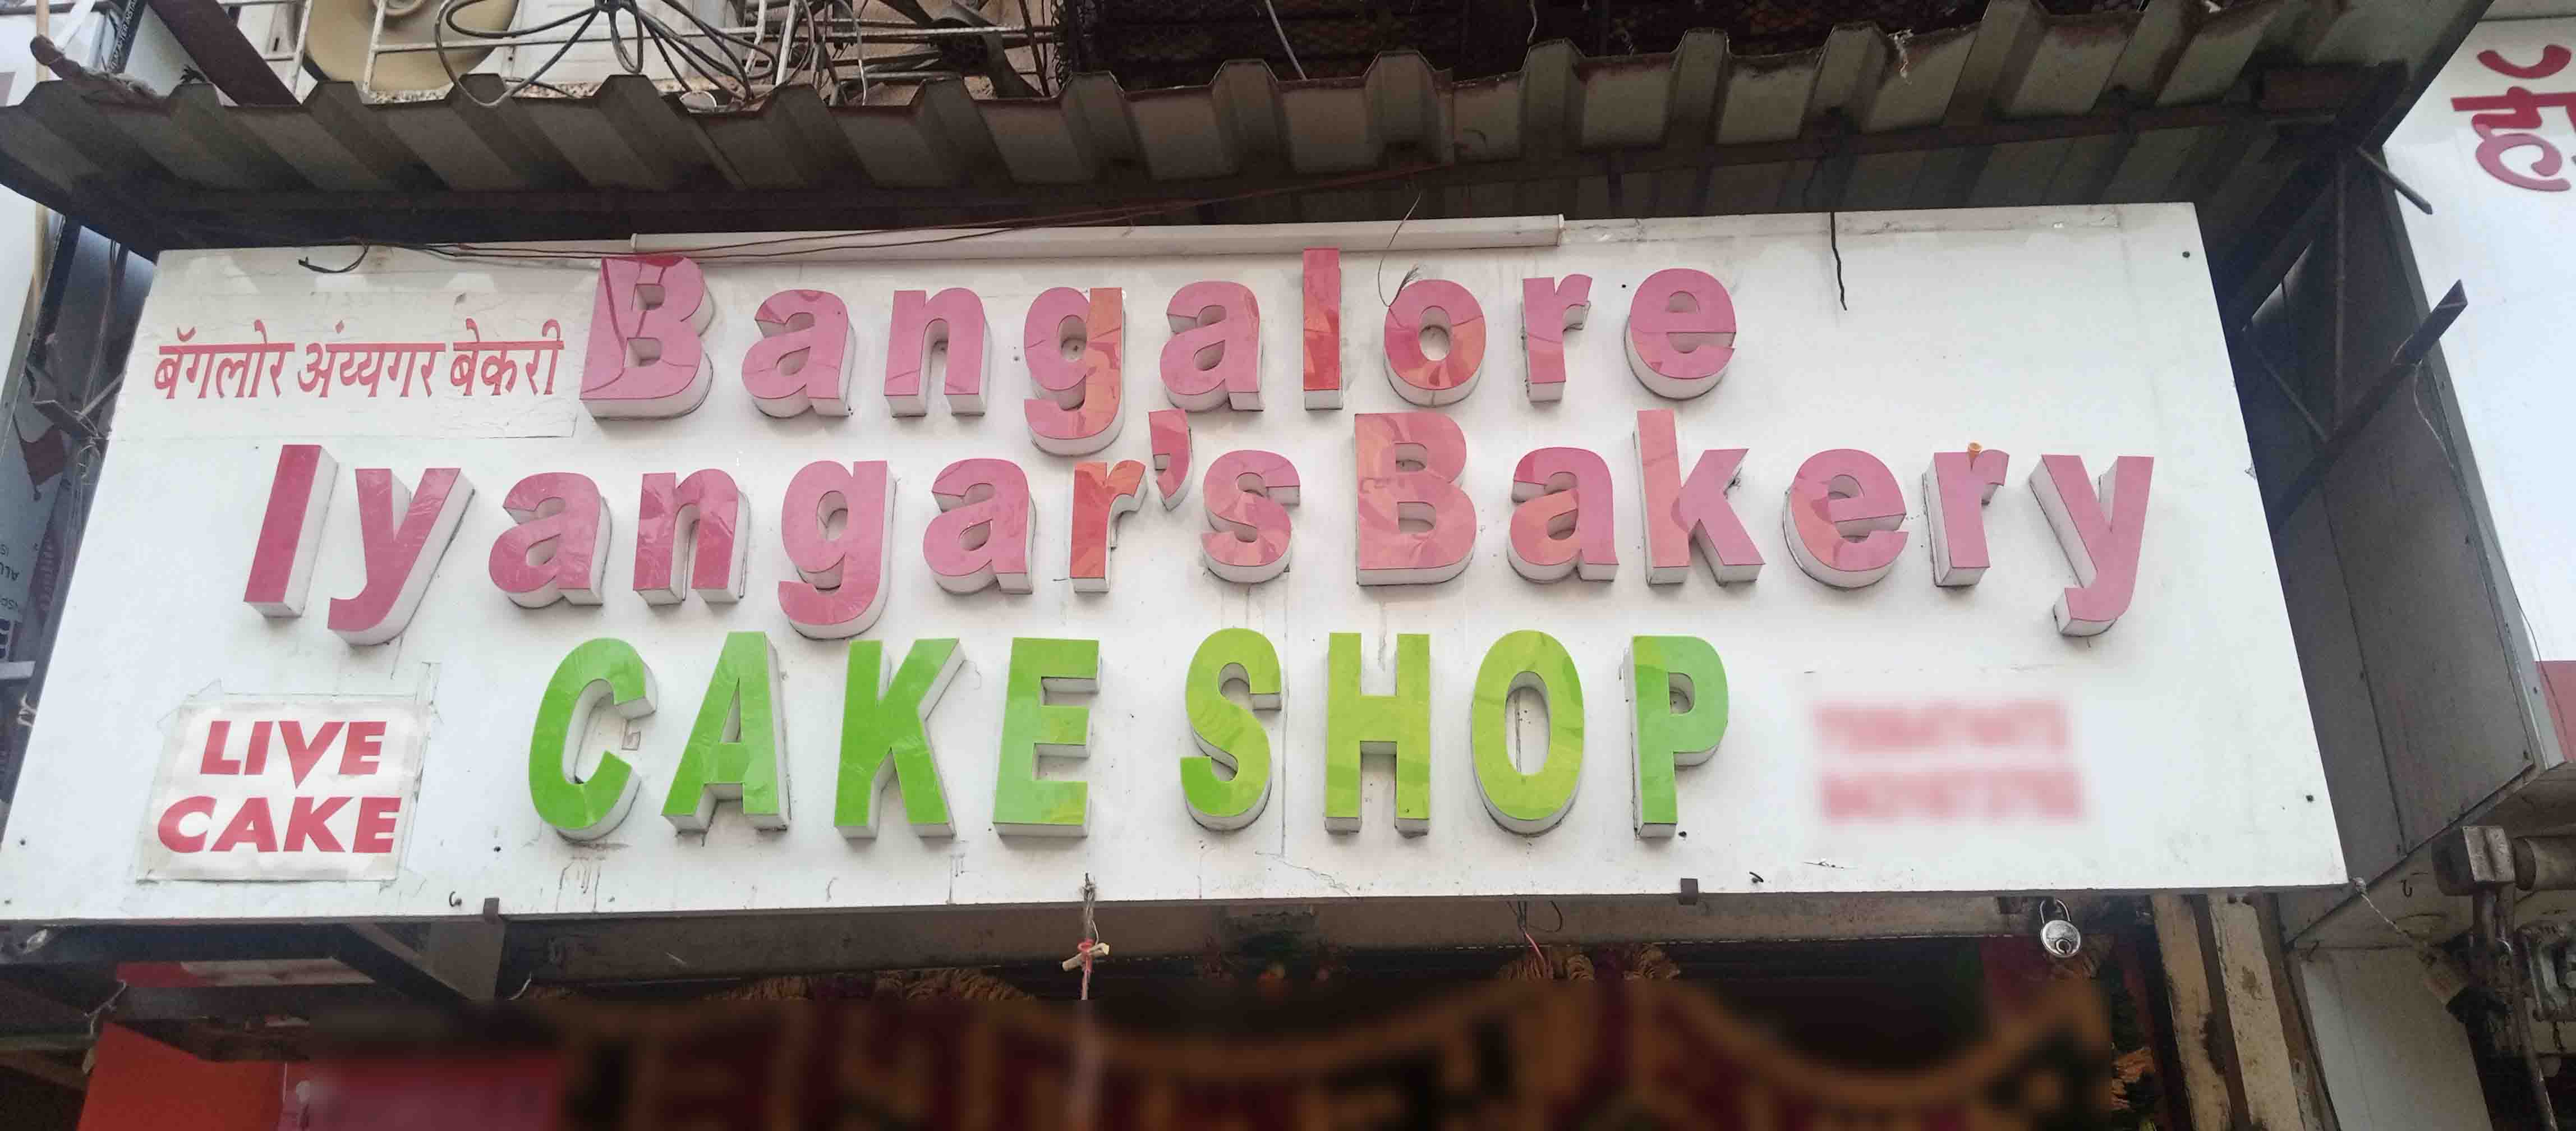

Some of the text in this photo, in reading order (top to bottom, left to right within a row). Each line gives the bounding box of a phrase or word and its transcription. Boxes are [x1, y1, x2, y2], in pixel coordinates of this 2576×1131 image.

[154, 318, 564, 399] बॅगलोर अंय्यगर बेकरी
[579, 249, 1737, 456] Bangalore
[243, 408, 2155, 645] Iyangar's Bakery
[200, 720, 387, 789] LIVE
[528, 628, 1728, 840] CAKE SHOP
[158, 796, 402, 853] CAKE
